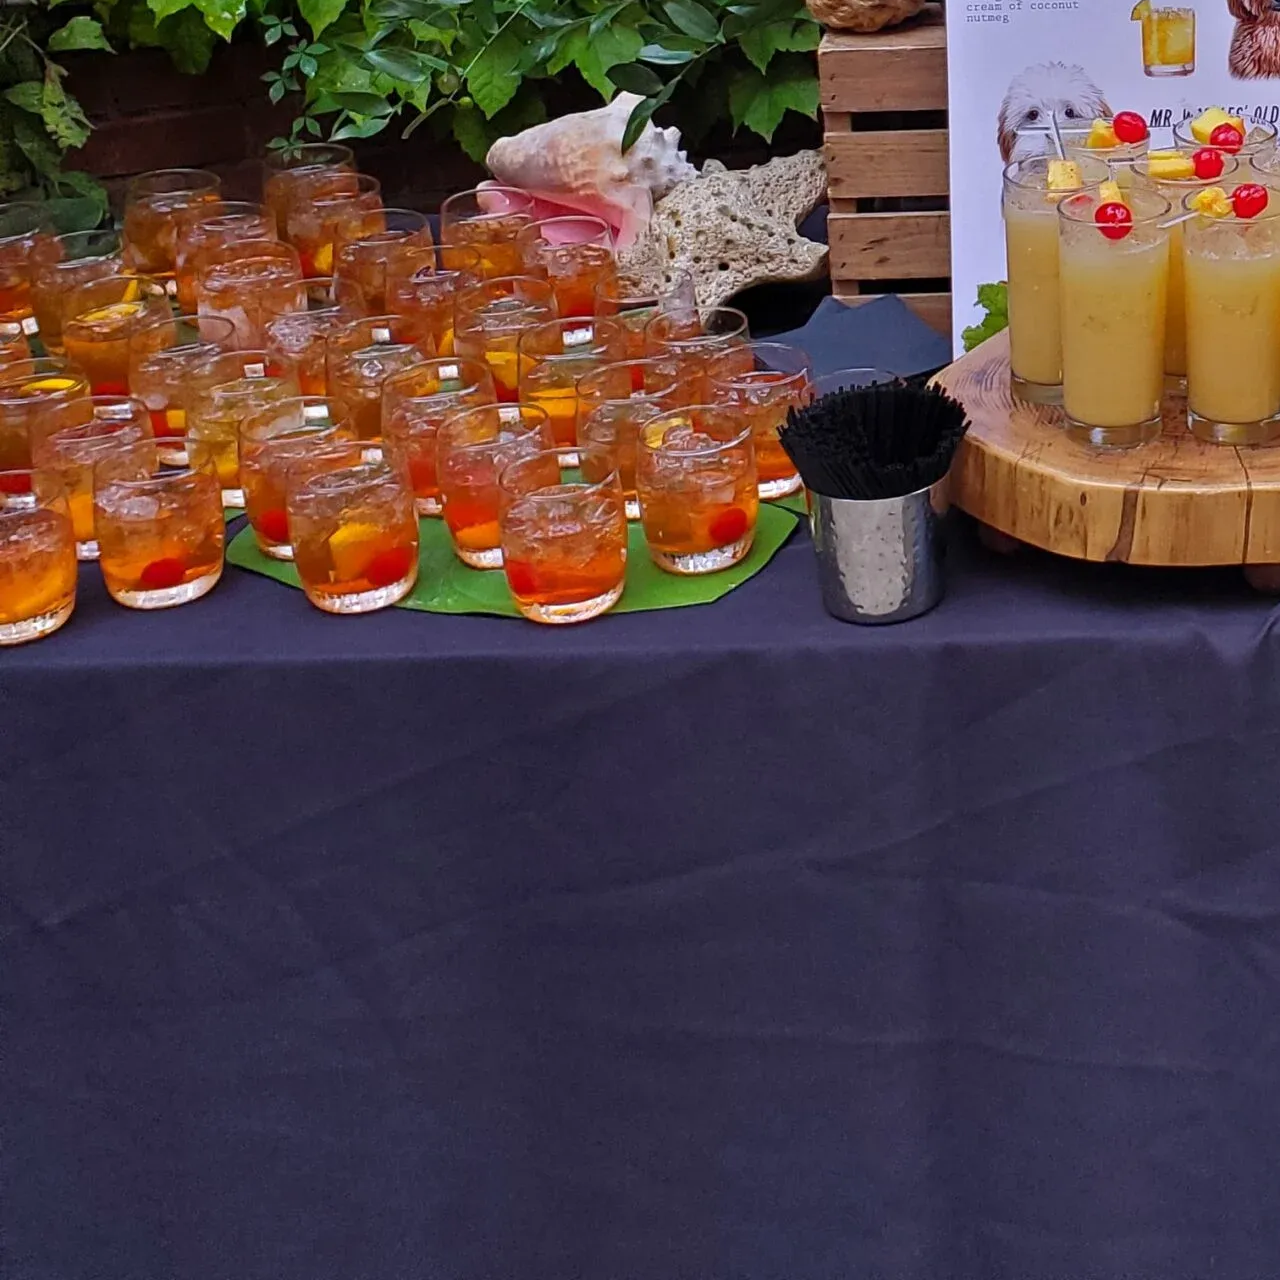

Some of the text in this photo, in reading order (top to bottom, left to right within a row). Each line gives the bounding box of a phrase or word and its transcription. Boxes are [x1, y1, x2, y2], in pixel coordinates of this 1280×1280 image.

[965, 0, 1079, 12] cream of coconut
[965, 13, 1011, 24] nutmeg
[1253, 105, 1280, 124] OLD
